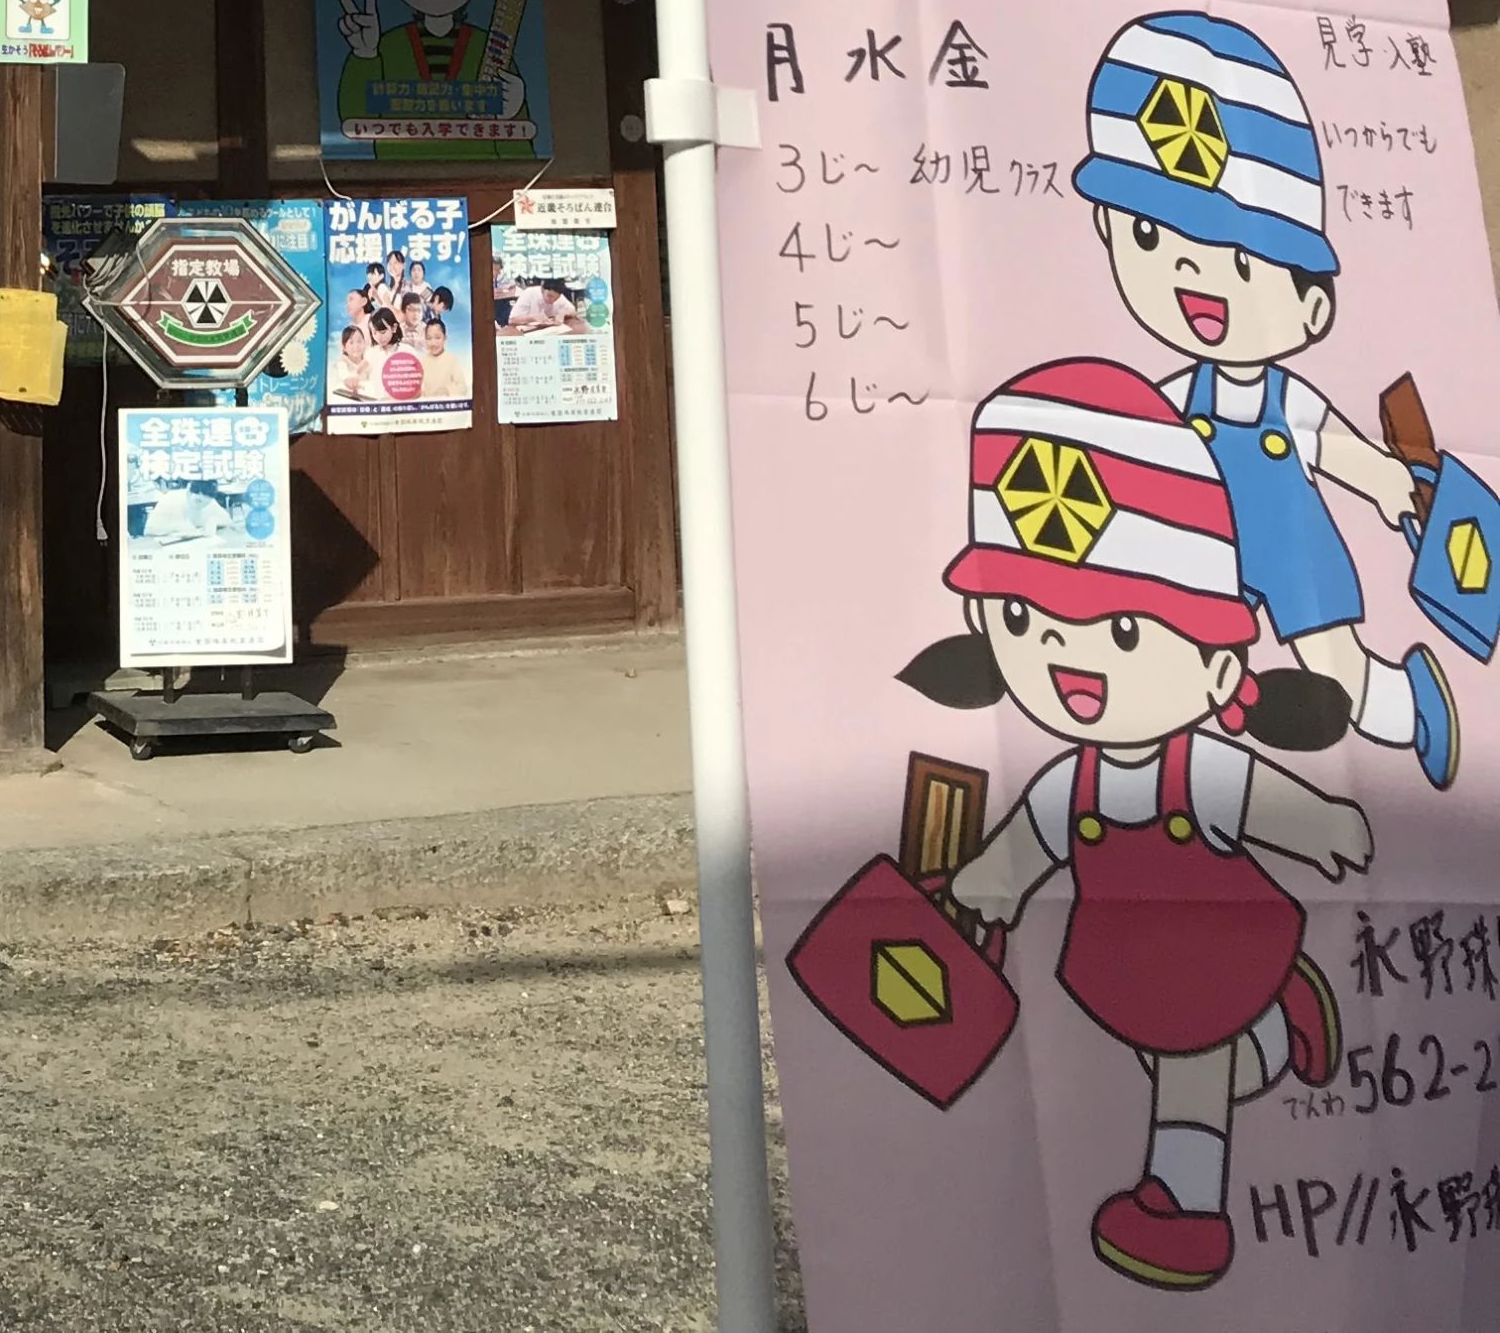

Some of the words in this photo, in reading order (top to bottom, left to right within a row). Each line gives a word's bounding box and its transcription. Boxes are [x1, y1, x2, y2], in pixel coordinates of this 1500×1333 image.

[355, 122, 527, 138] いつでも入学できます!
[1322, 121, 1437, 154] いつからでも
[329, 200, 463, 231] がんばる子
[1337, 185, 1414, 231] できます
[329, 231, 466, 264] 応援します!
[172, 259, 240, 277] 指定教場
[502, 253, 600, 279] 検定試験
[139, 417, 233, 448] 全珠連
[140, 450, 266, 481] 検定試験
[1350, 910, 1500, 1001] 永野珠
